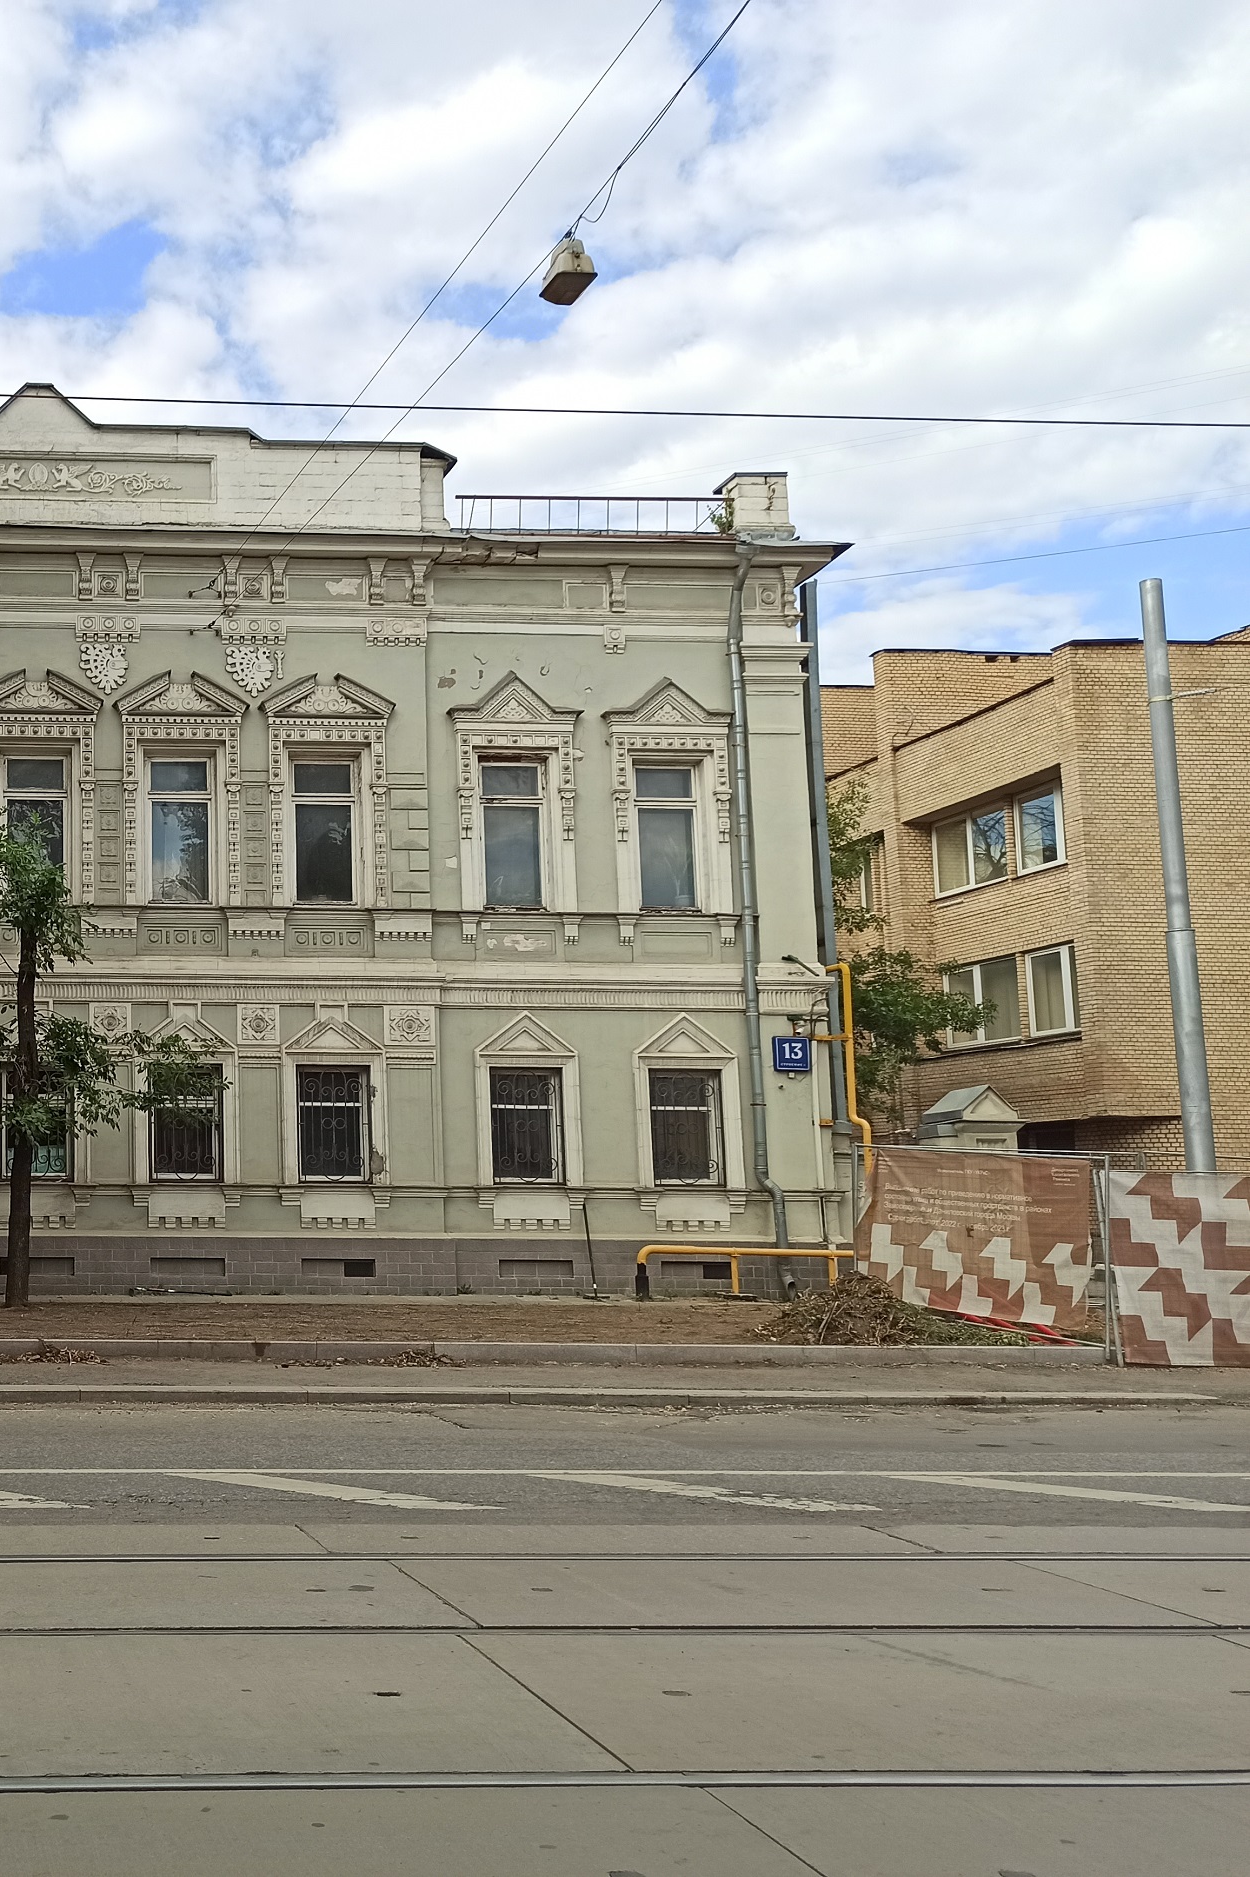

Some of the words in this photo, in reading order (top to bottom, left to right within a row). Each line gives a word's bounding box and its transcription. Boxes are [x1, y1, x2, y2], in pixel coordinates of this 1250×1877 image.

[782, 1042, 802, 1060] 13
[1025, 1205, 1053, 1214] районах
[940, 1219, 957, 1228] 2022
